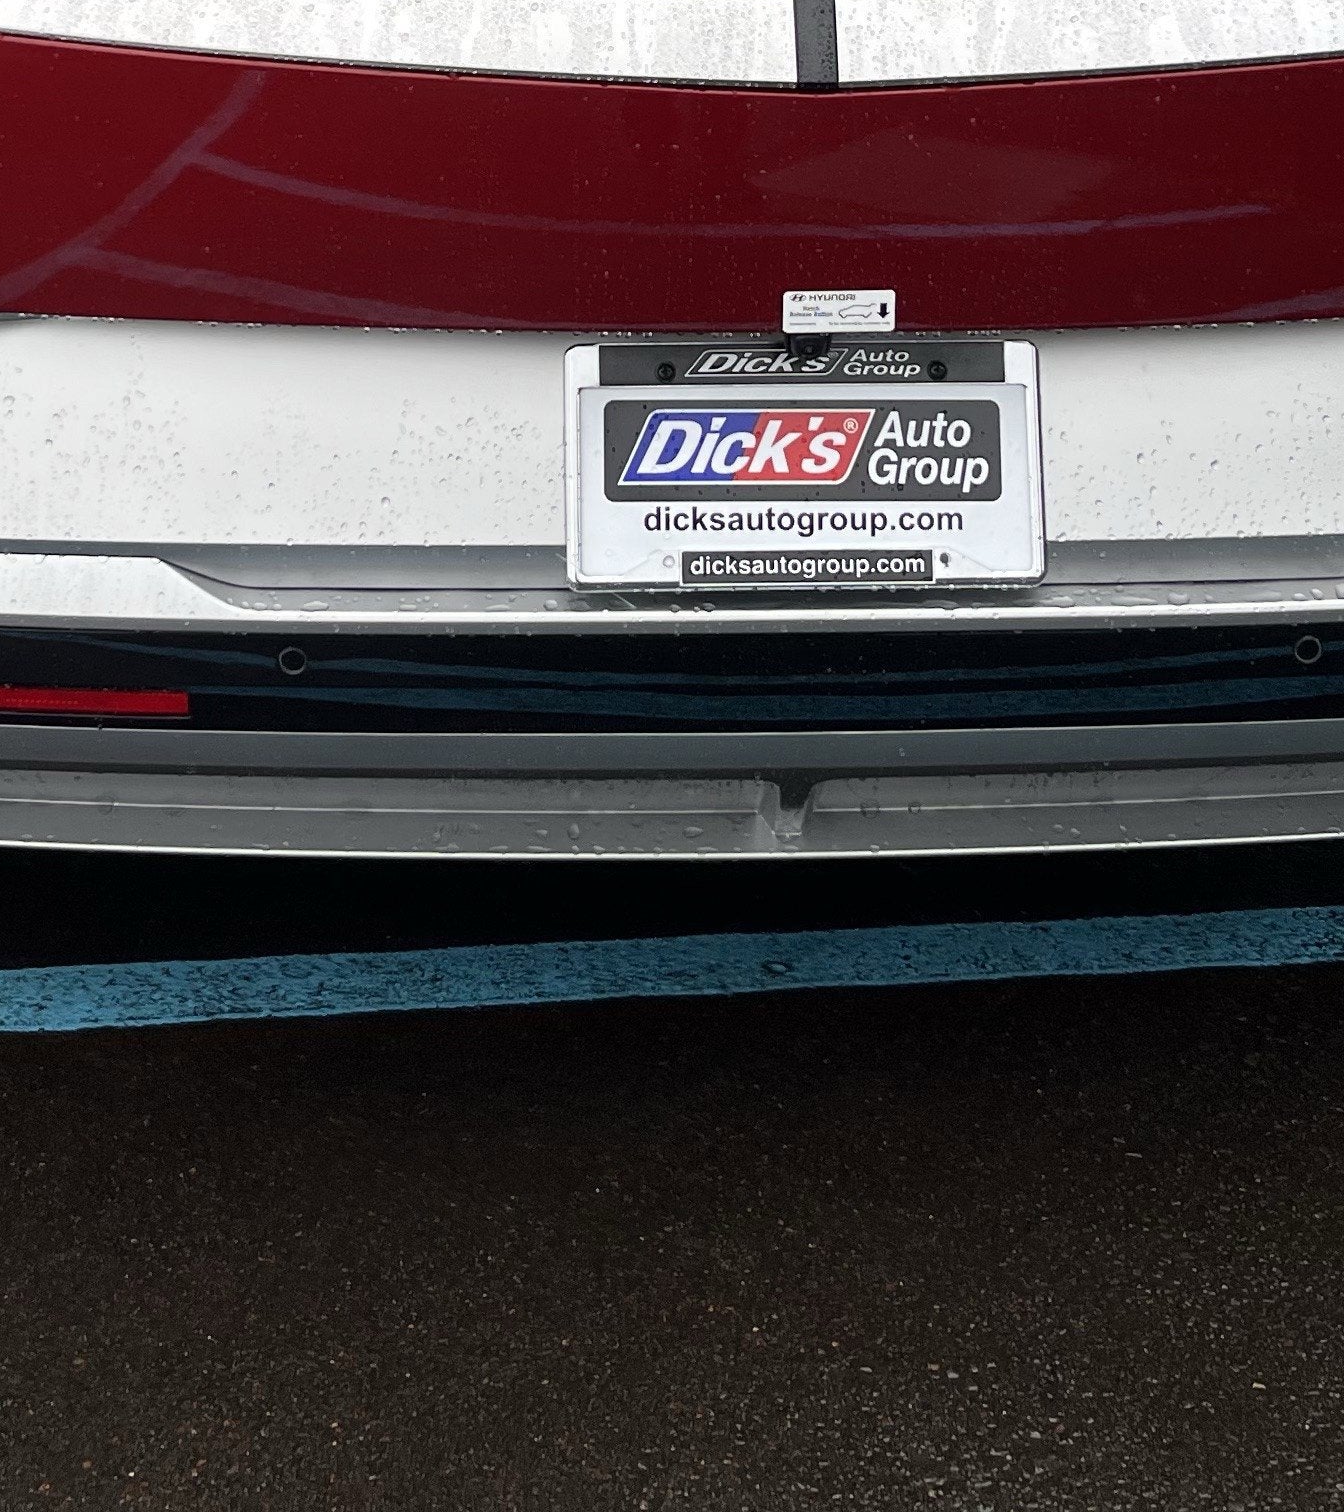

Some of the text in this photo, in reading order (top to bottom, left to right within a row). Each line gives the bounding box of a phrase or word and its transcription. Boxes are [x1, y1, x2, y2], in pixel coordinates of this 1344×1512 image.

[808, 293, 856, 302] HYUNDAI
[697, 352, 830, 373] Dicks
[849, 349, 910, 362] Auto
[843, 362, 921, 377] Group
[873, 410, 972, 448] Auto
[636, 416, 847, 474] Dick's
[867, 448, 989, 493] Group
[643, 506, 964, 537] dicksautogroup.com
[689, 554, 926, 578] dicksautogroup.com
